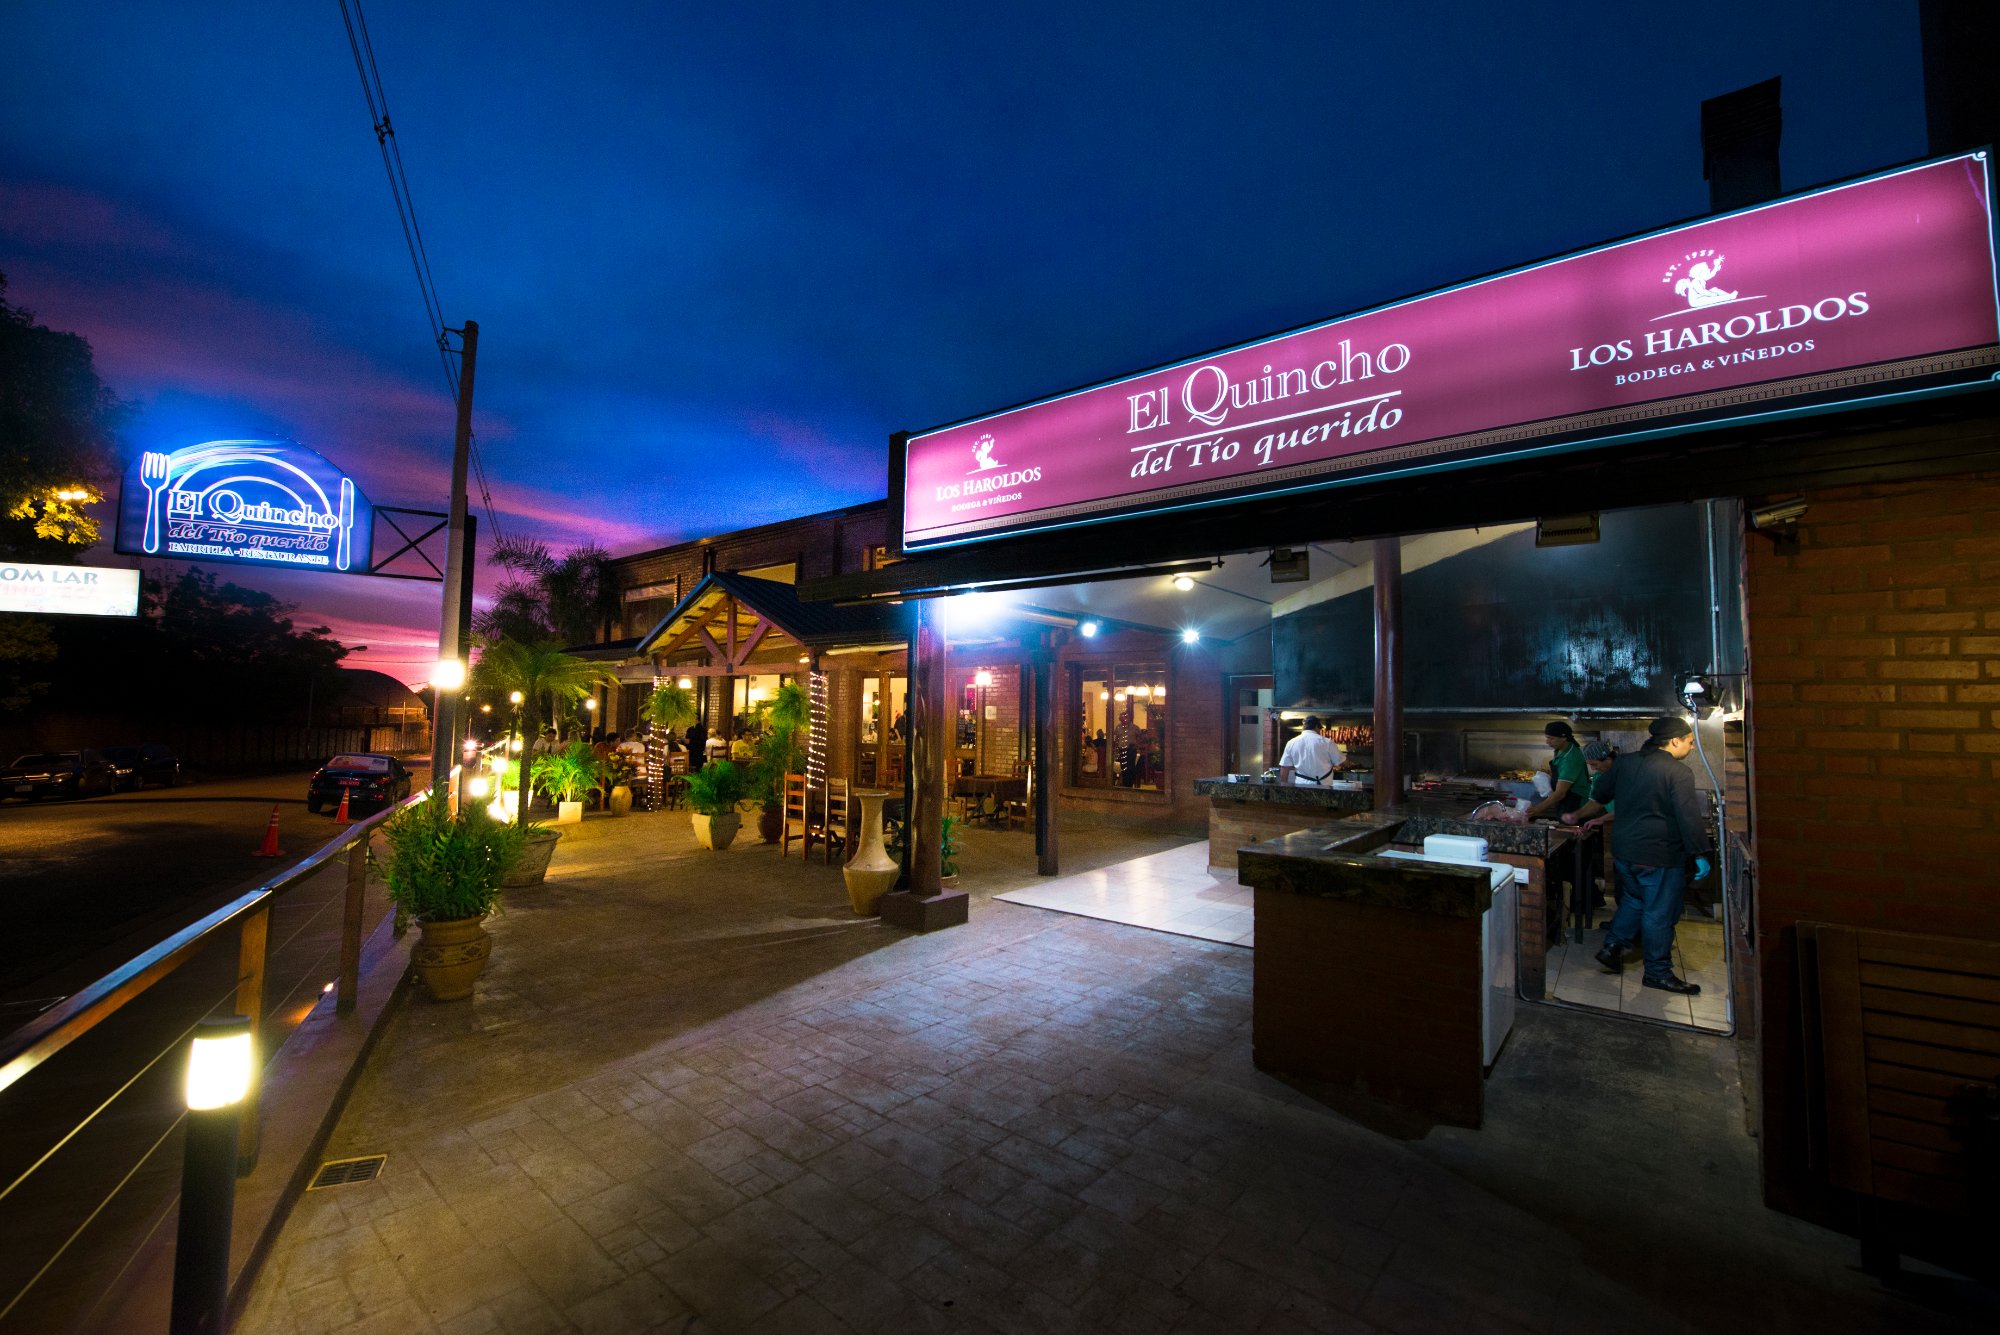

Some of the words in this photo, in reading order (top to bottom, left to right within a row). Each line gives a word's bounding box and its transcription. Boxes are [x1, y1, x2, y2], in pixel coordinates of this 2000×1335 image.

[1569, 340, 1633, 371] LOS
[1643, 291, 1870, 357] HAROLDOS
[1615, 361, 1696, 386] BODEGA
[1701, 359, 1715, 370] &
[1718, 339, 1816, 367] VIÑEDOS
[1126, 387, 1171, 434] El
[1181, 339, 1411, 427] Quincho
[1130, 443, 1182, 479] del
[1186, 437, 1241, 468] Tío
[1253, 398, 1403, 466] querido
[936, 485, 960, 502] LOS
[963, 466, 1042, 496] HAROLDOS
[952, 500, 981, 512] BODEGA
[988, 492, 1022, 505] VIÑEDOS
[168, 489, 203, 516] El
[208, 489, 339, 530] Quincho
[168, 525, 208, 540] del
[248, 530, 329, 551] querido
[52, 570, 98, 585] LAR
